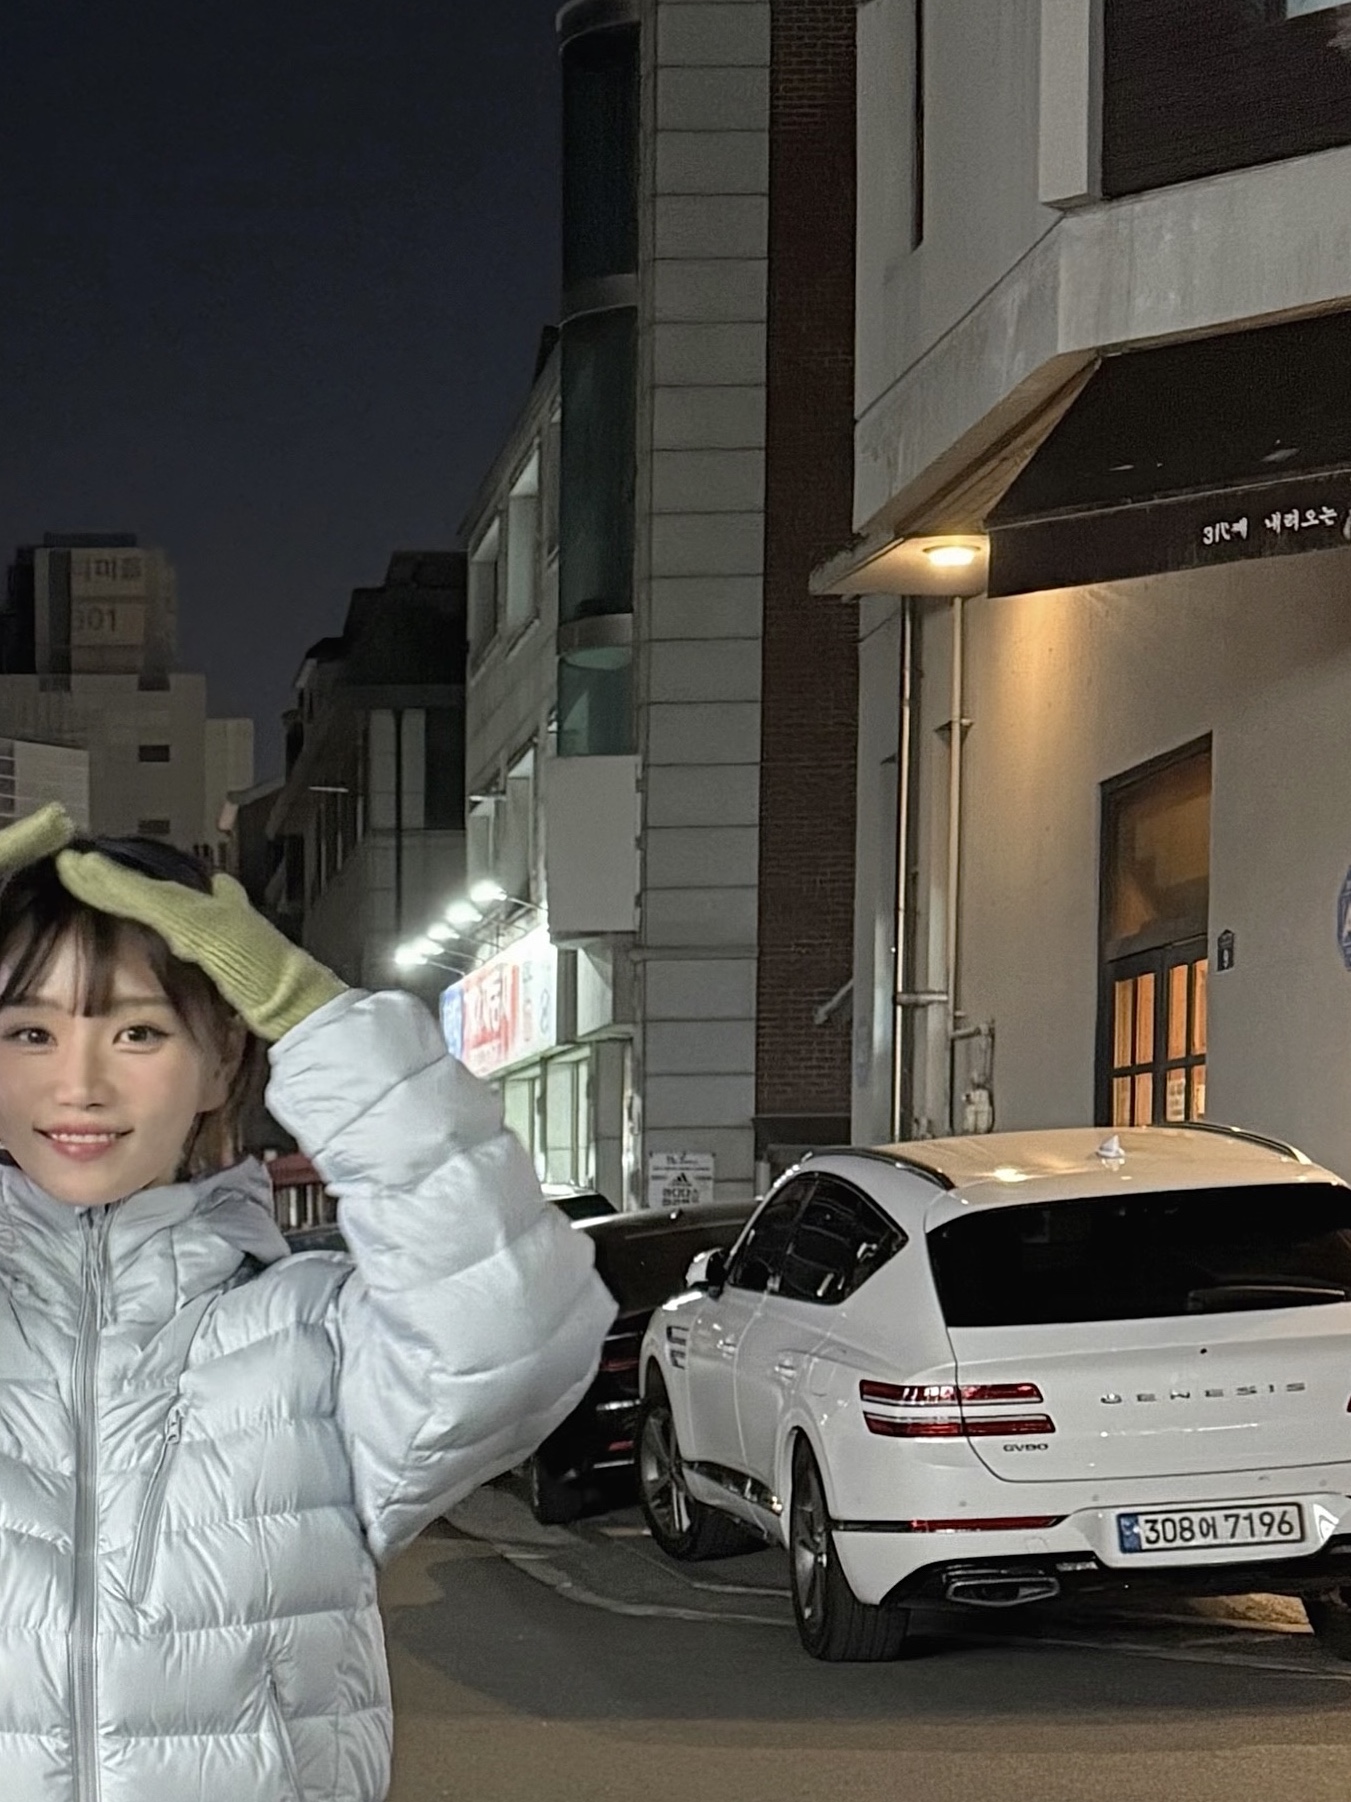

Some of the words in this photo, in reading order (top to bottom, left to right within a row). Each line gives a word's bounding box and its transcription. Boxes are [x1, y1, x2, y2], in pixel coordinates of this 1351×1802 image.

[1264, 506, 1338, 534] 내려오는
[1144, 1516, 1218, 1545] 308어
[1224, 1510, 1295, 1540] 7196
